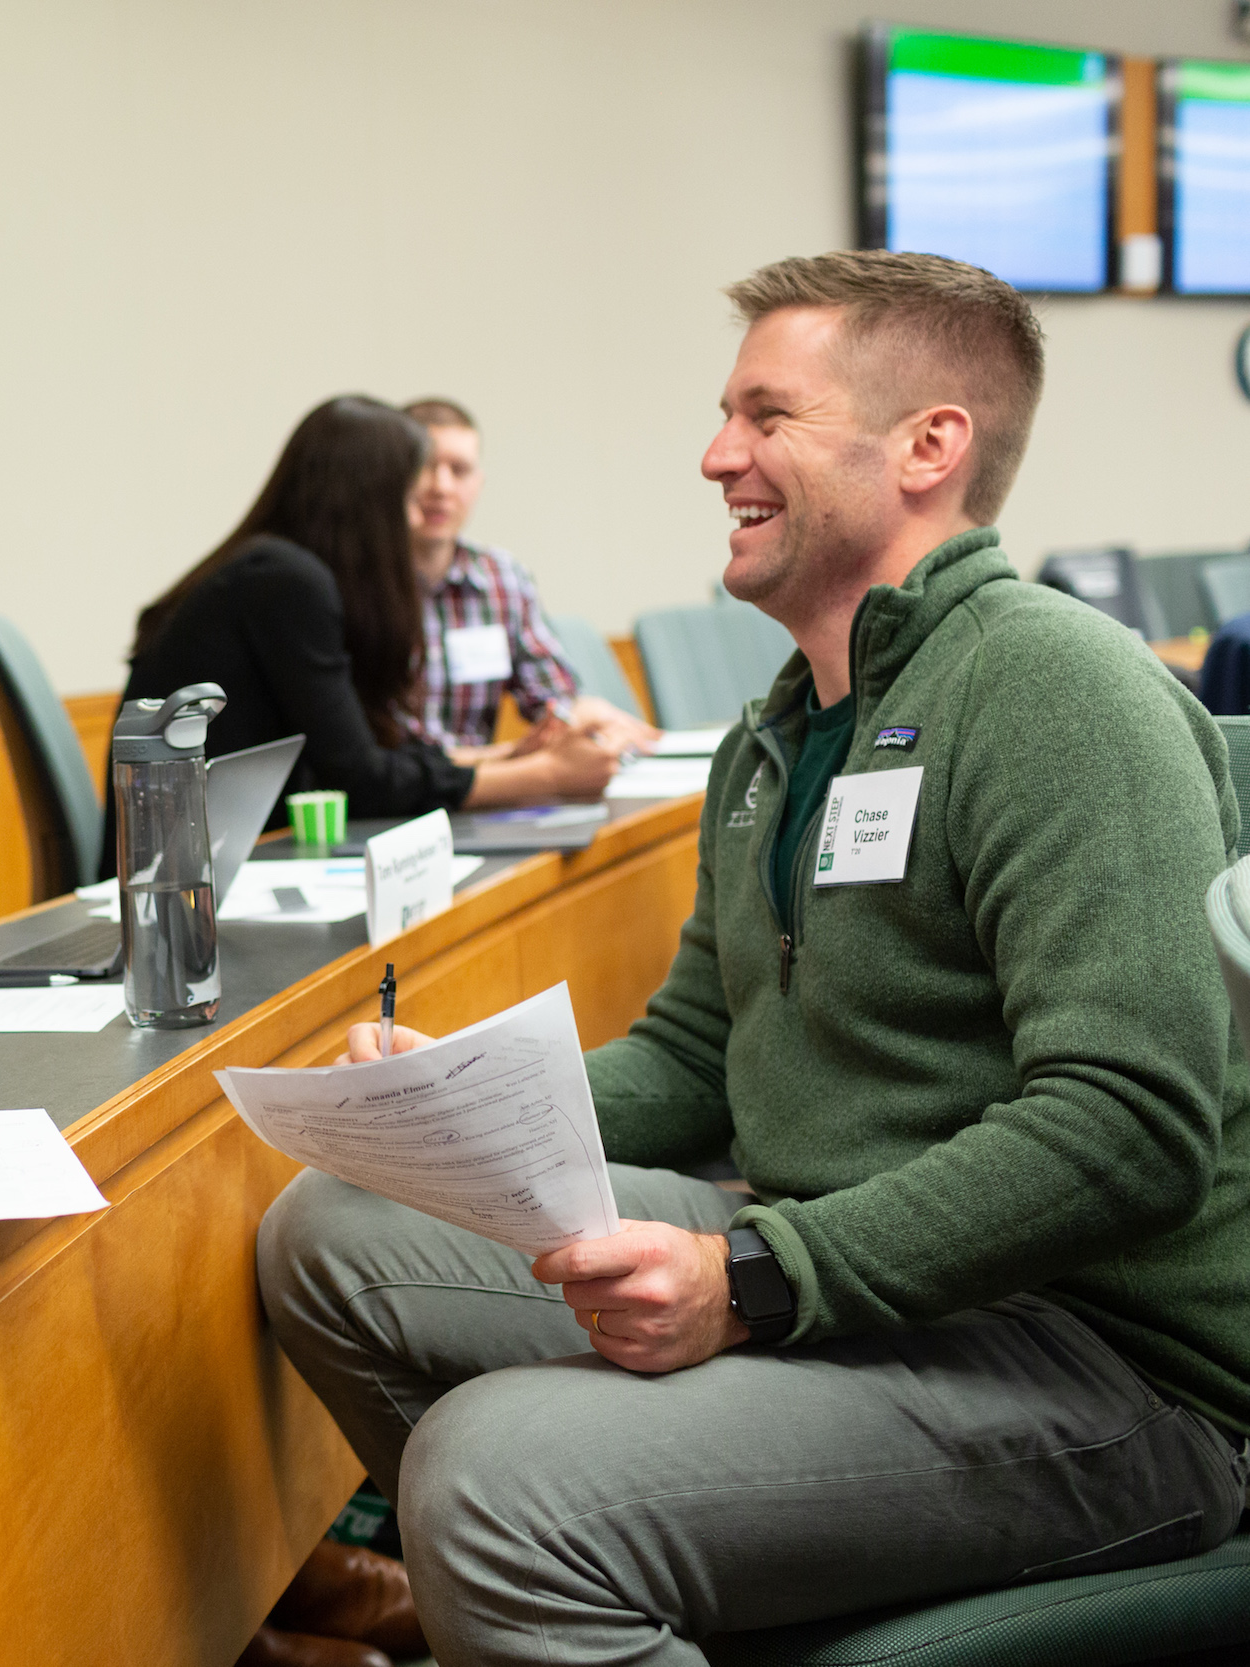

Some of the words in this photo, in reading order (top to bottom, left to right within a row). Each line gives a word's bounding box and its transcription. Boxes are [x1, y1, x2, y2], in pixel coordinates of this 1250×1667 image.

[822, 826, 834, 852] NEXT
[828, 797, 840, 823] STEP
[854, 809, 889, 824] Chase
[853, 828, 890, 844] Vizzier
[365, 1091, 401, 1102] Amanda
[403, 1082, 435, 1095] Elmore
